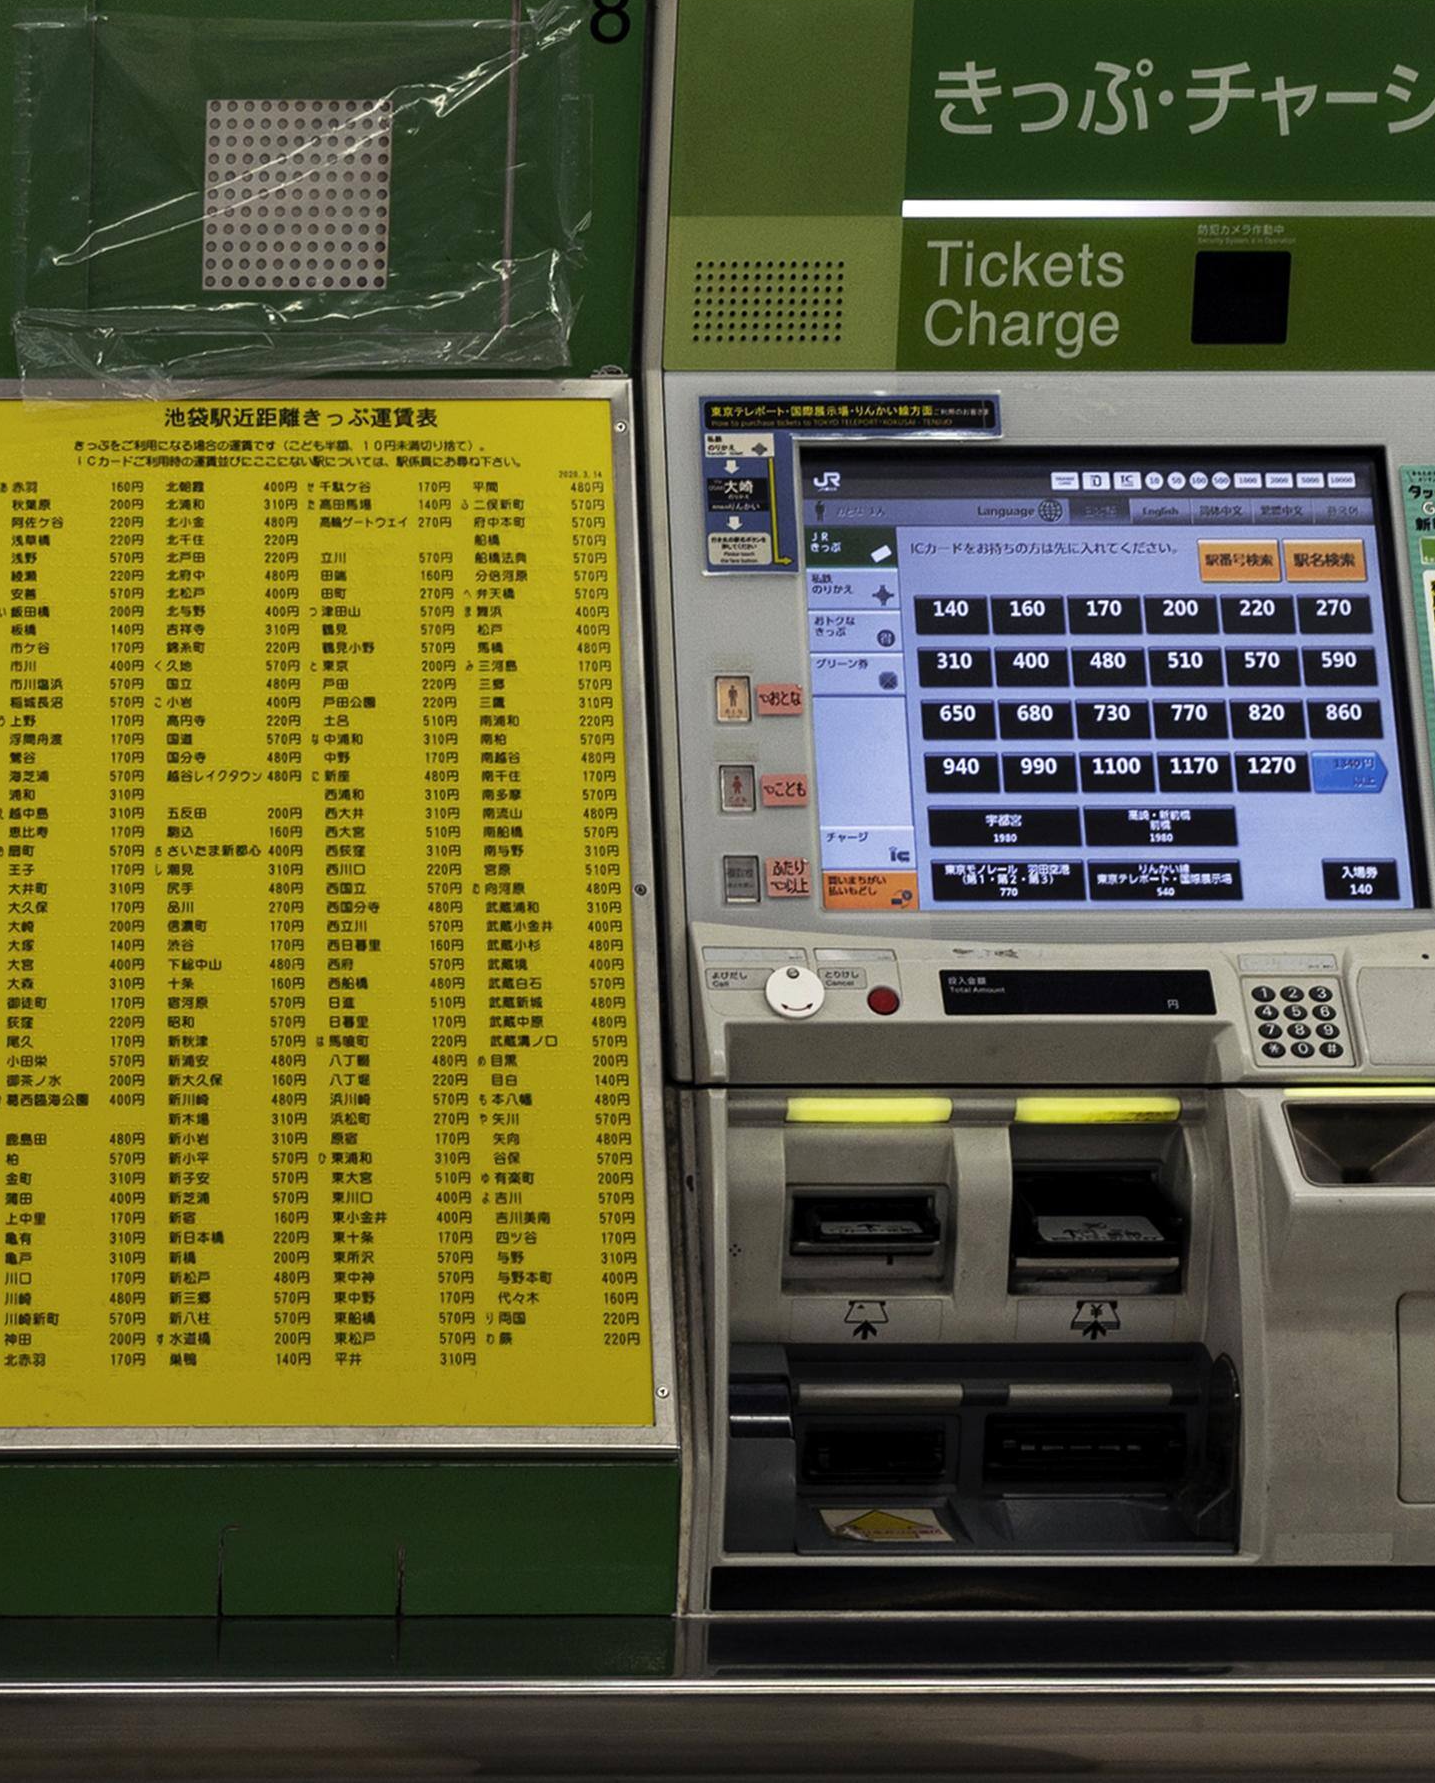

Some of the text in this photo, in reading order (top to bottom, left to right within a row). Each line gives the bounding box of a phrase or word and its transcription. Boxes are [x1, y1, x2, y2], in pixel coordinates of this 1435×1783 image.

[926, 240, 1124, 288] Tickets
[924, 298, 1120, 356] Charge
[164, 406, 438, 428] 池袋駅近距離きっぷ運賃表
[418, 480, 452, 493] 170円
[977, 506, 1035, 518] Language
[110, 533, 145, 547] 220円
[1293, 552, 1357, 568] 駅名検索
[933, 600, 969, 617] 140
[1316, 598, 1352, 616] 270
[110, 659, 145, 673] 400円
[1167, 651, 1204, 669] 510
[1326, 703, 1362, 721] 860
[1092, 756, 1141, 775] 1100
[1170, 756, 1219, 775] 1170
[1347, 882, 1375, 895] 140
[109, 1073, 146, 1087] 200円
[273, 1231, 310, 1246] 220円
[109, 1271, 146, 1286] 170円
[602, 1291, 640, 1305] 160円
